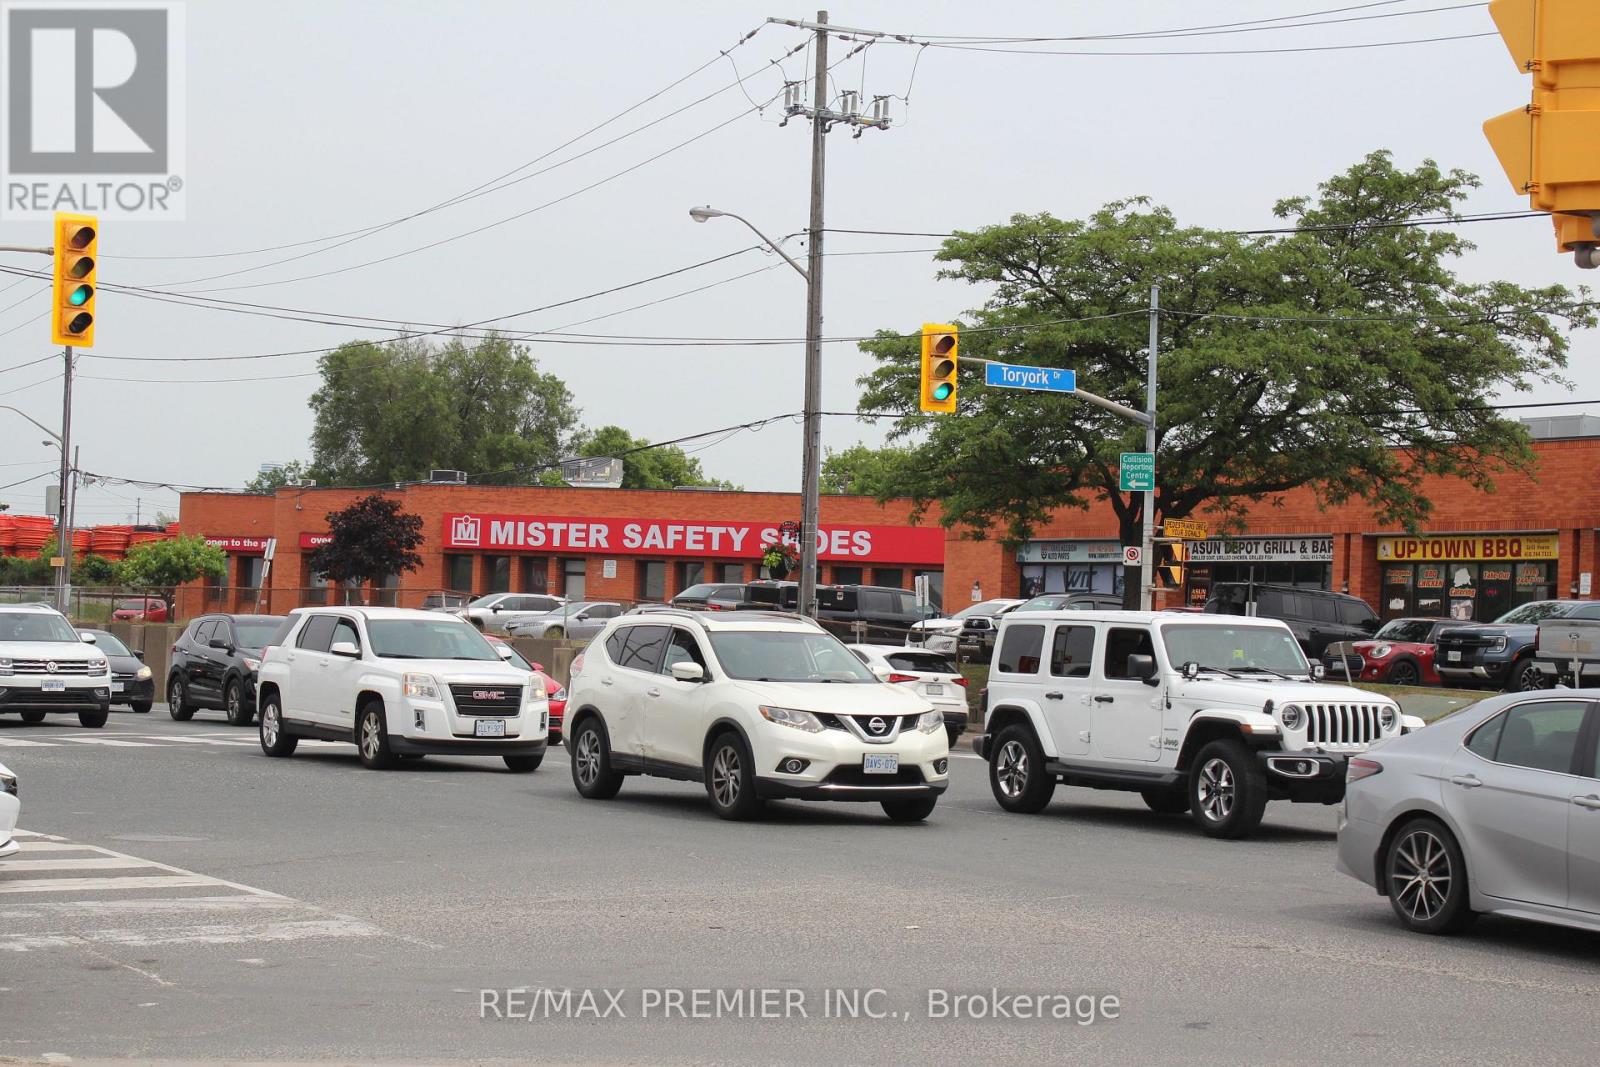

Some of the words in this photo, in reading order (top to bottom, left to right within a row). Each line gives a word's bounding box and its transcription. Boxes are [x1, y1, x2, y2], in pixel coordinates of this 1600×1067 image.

[1001, 367, 1048, 385] Toryork
[1053, 371, 1061, 380] Dr
[1122, 455, 1153, 464] Collision
[1122, 463, 1153, 473] Reporting
[490, 520, 609, 549] MISTER
[622, 523, 750, 552] SAFETY
[231, 538, 240, 547] to
[243, 538, 259, 548] the
[1192, 541, 1221, 555] ASUN
[1264, 540, 1296, 555] GRILL
[1300, 540, 1308, 554] &
[1312, 540, 1334, 554] BAR
[1393, 539, 1476, 559] UPTOWN
[1483, 538, 1522, 558] BBQ
[472, 690, 506, 700] GMC
